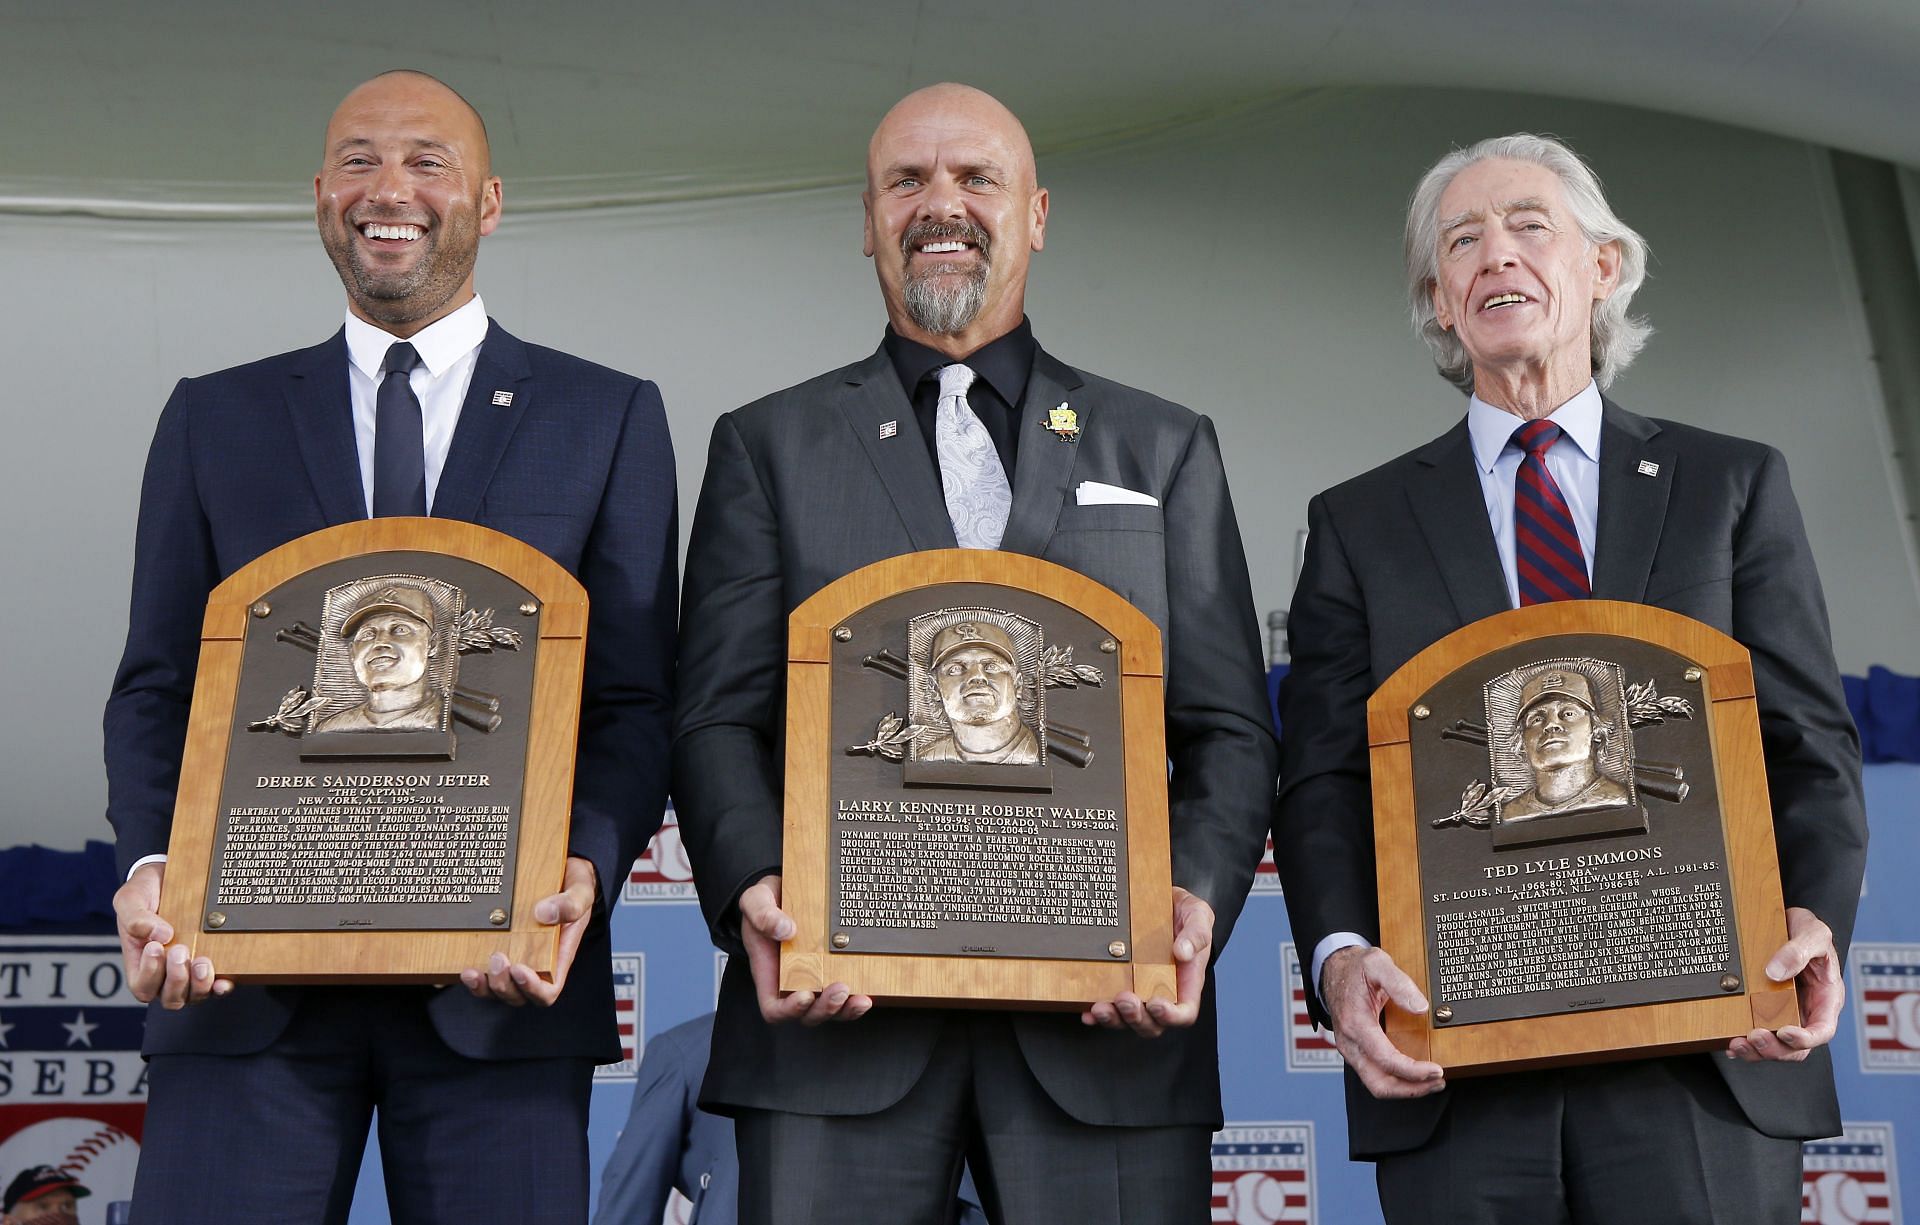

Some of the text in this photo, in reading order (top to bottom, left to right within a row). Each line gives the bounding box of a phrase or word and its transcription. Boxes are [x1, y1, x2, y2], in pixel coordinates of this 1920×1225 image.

[255, 774, 491, 787] DEREK SANDERSON JETER
[297, 796, 444, 805] NEW YORK, A.L. 1995-2014
[230, 806, 509, 815] HEARTBEAT OF A YANKEES DYNASTY. DEFINED A TWO-DECADE RUN
[839, 800, 1116, 820] LARRY KENNETH ROBERT WALKER
[228, 814, 508, 824] OF BRONX DOMINANCE THAT PRODUCED 17 POSTSEASON
[837, 813, 1118, 831] MONTREAL, N.L. 1989-94; COLORADO, N.L. 1995-2004;
[226, 832, 507, 841] WORLD SERIES CHAMPIONSHIPS. SELECTED TO 14 ALL-STAR GAMES
[227, 823, 508, 834] APPEARANCES, SEVEN AMERICAN LEAGUE PENNANTS AND FIVE
[917, 823, 1038, 834] ST. LOUIS, N.L. 2004-05
[841, 830, 1115, 847] DYNAMIC RIGHT FIELDER WITH A FEARED PLATE PRESENCE WHO
[841, 839, 1116, 856] BROUGHT ALL-OUT EFFORT AND FIVE-TOOL SKILL SET TO HIS
[841, 847, 1115, 865] NATIVE CANADA'S EXPOS BEFORE BECOMING ROCKIES SUPERSTAR.
[840, 856, 882, 866] SELECTED
[885, 857, 895, 866] AS
[899, 858, 916, 867] 1997
[920, 858, 962, 868] NATIONAL
[965, 860, 998, 869] LEAGUE
[1002, 861, 1025, 870] M.V.P.
[1028, 862, 1054, 871] AFTER
[1057, 863, 1099, 872] AMASSING
[1483, 846, 1662, 879] TED LYLE SIMMONS
[630, 884, 688, 896] HALL OF
[1432, 891, 1449, 902] ST.
[1452, 887, 1491, 901] LOUIS,
[1494, 884, 1517, 895] N.L.
[1522, 878, 1565, 893] 1968-80;
[1569, 869, 1643, 888] MILWAUKEE,
[1646, 867, 1669, 878] A.L.
[1511, 878, 1639, 901] ATLANTA, N.L. 1986-88
[1435, 882, 1721, 922] TOUGH-AS-NAILS SWITCH-HITTING CATCHER WHOSE PLATE
[1436, 890, 1722, 931] PRODUCTION PLACES HIM IN THE UPPER ECHELON AMONG BACKSTOPS.
[1437, 930, 1448, 940] AT
[1449, 928, 1469, 938] TIME
[1471, 926, 1482, 936] OF
[1484, 920, 1538, 935] RETIREMENT,
[1540, 918, 1557, 928] LED
[1558, 916, 1574, 926] ALL
[1576, 911, 1619, 924] CATCHERS
[1620, 908, 1642, 919] WITH
[1668, 903, 1687, 914] HITS
[1688, 901, 1707, 911] AND
[1437, 936, 1477, 949] DOUBLES,
[1480, 931, 1518, 943] RANKING
[1522, 927, 1554, 939] EIGHTH
[1557, 924, 1578, 935] WITH
[1607, 918, 1635, 929] GAMES
[1639, 914, 1671, 926] BEHIND
[1673, 912, 1691, 922] THE
[1695, 908, 1724, 919] PLATE.
